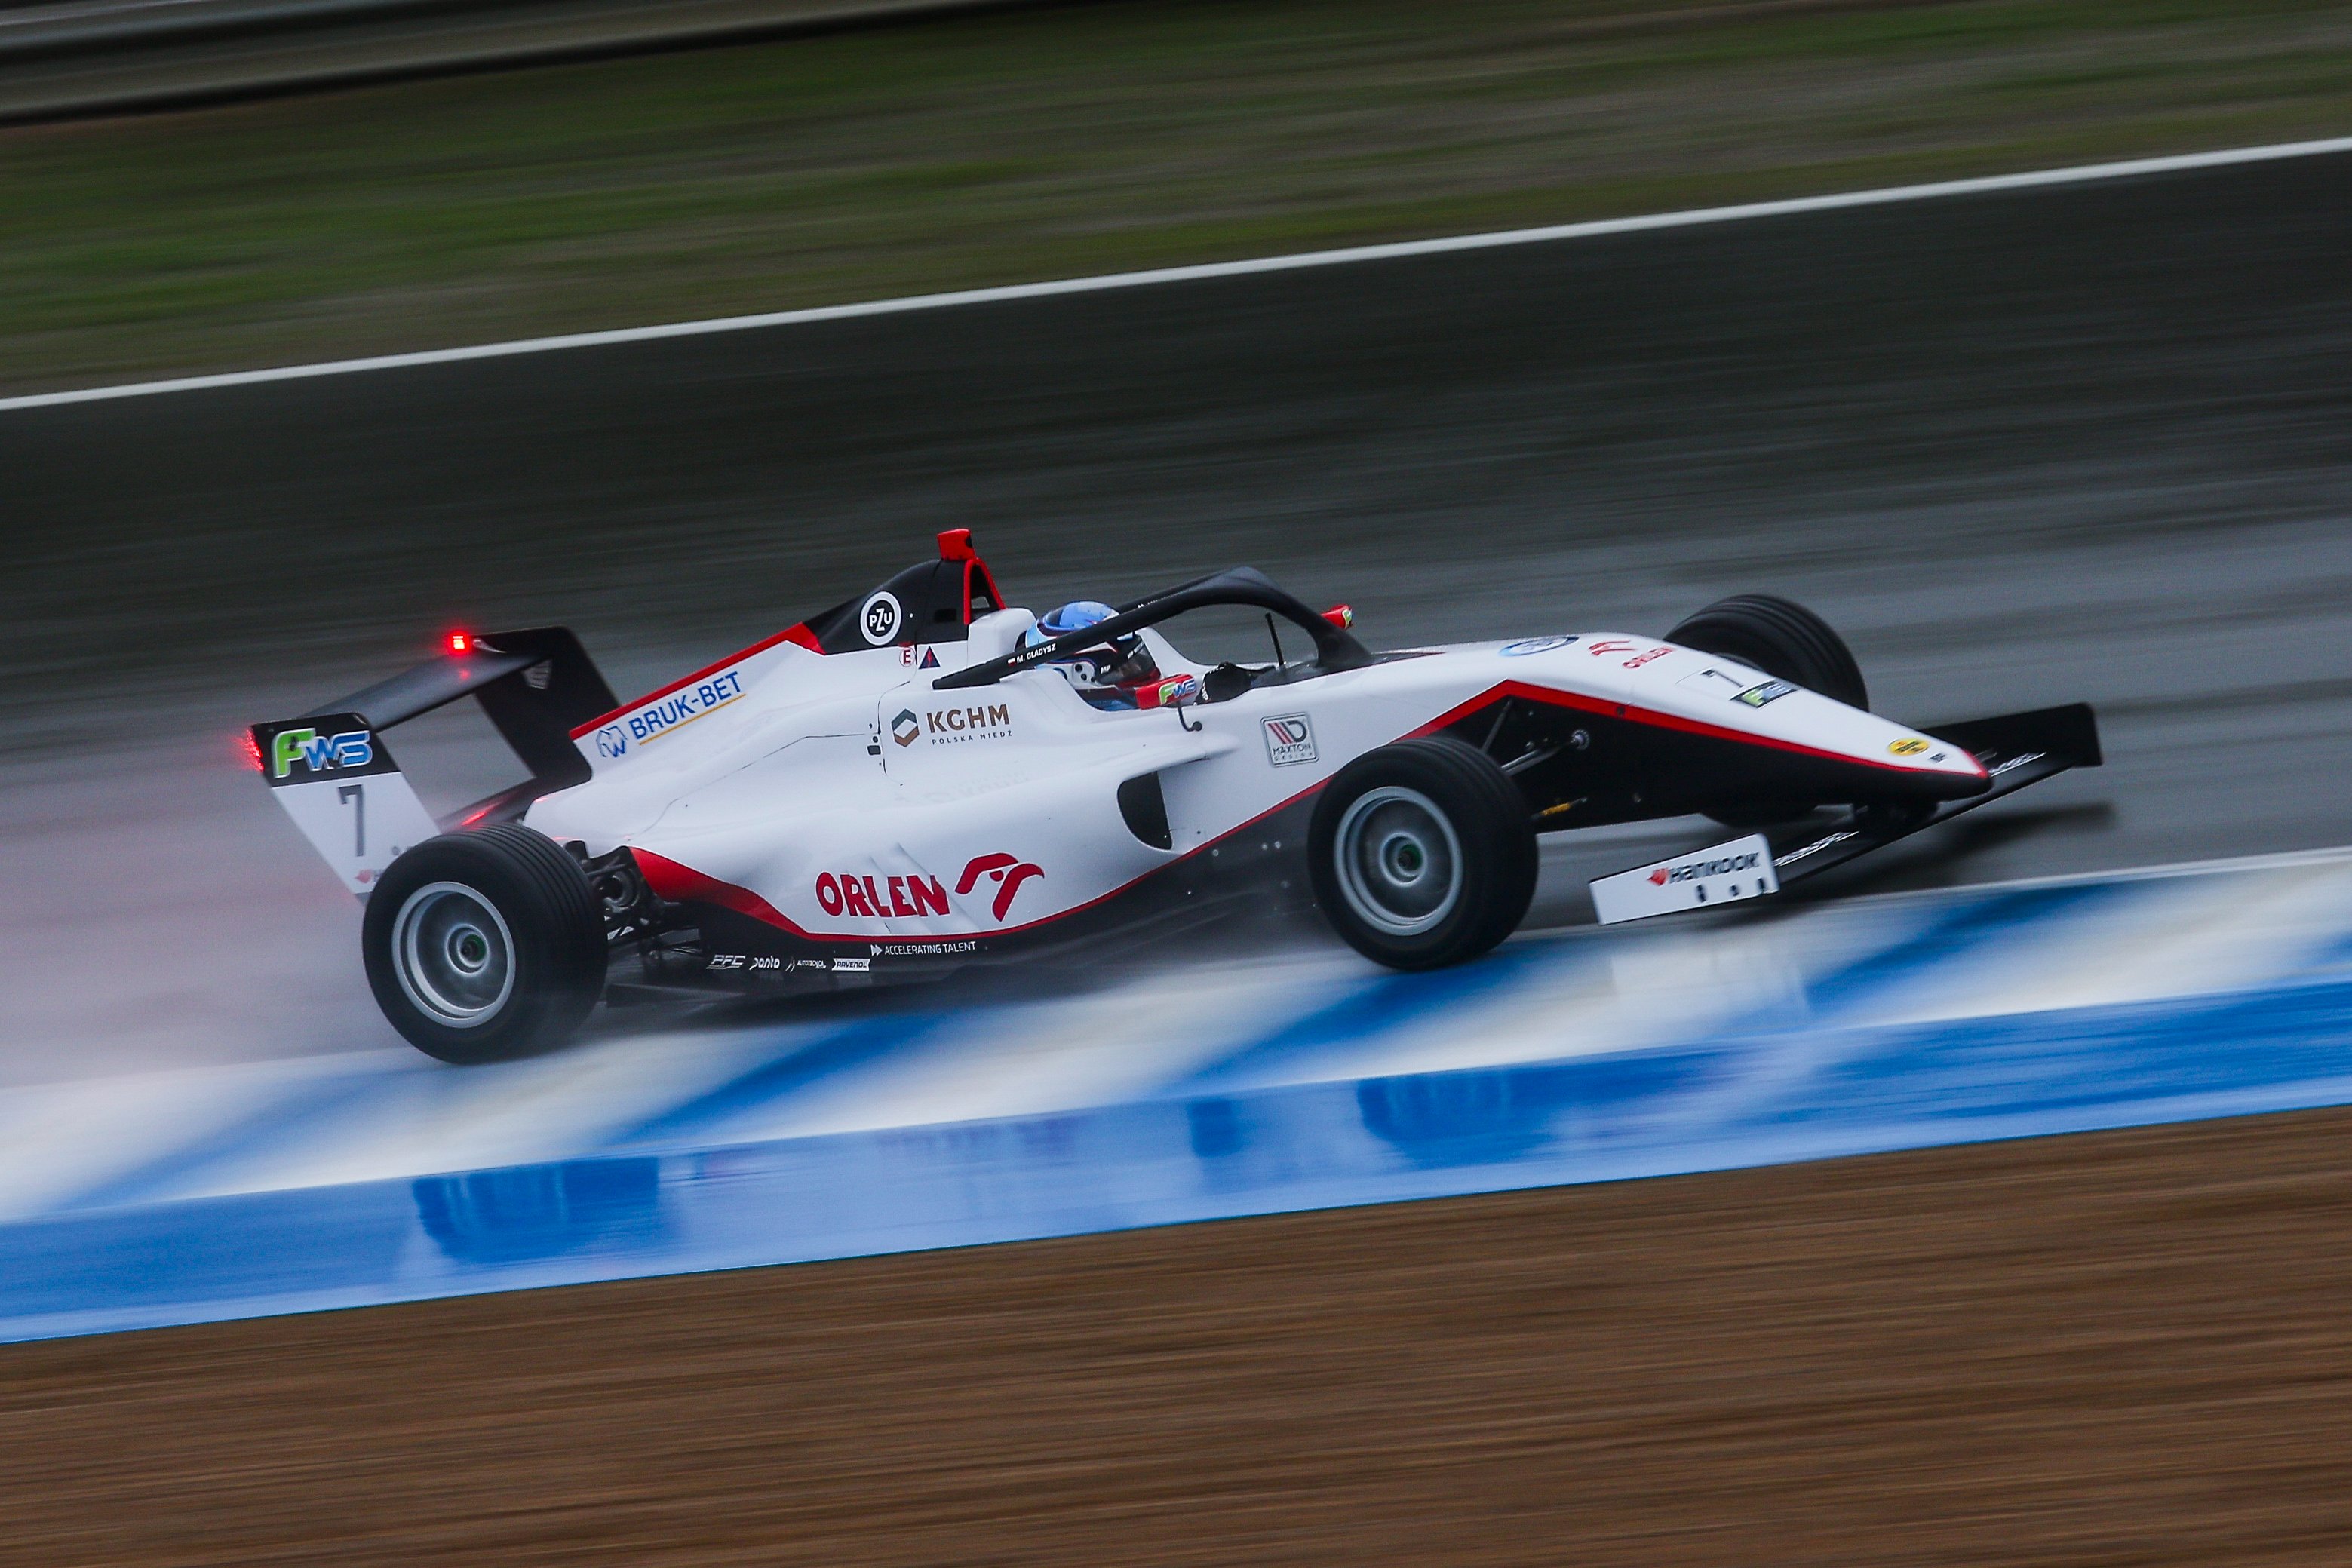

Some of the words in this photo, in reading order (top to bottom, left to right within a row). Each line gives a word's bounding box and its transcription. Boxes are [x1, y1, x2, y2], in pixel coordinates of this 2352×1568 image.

[869, 608, 892, 631] PZU
[903, 649, 910, 664] E
[1016, 654, 1025, 664] M.
[1027, 643, 1056, 660] GLADYSZ
[629, 671, 740, 739] BRUK-BET
[926, 704, 1010, 733] KGHM
[272, 728, 373, 778] FWS
[932, 735, 973, 745] POLSKA
[337, 784, 365, 857] 7
[815, 872, 950, 917] ORLEN
[885, 944, 941, 955] ACCELERATING
[942, 941, 976, 953] TALENT
